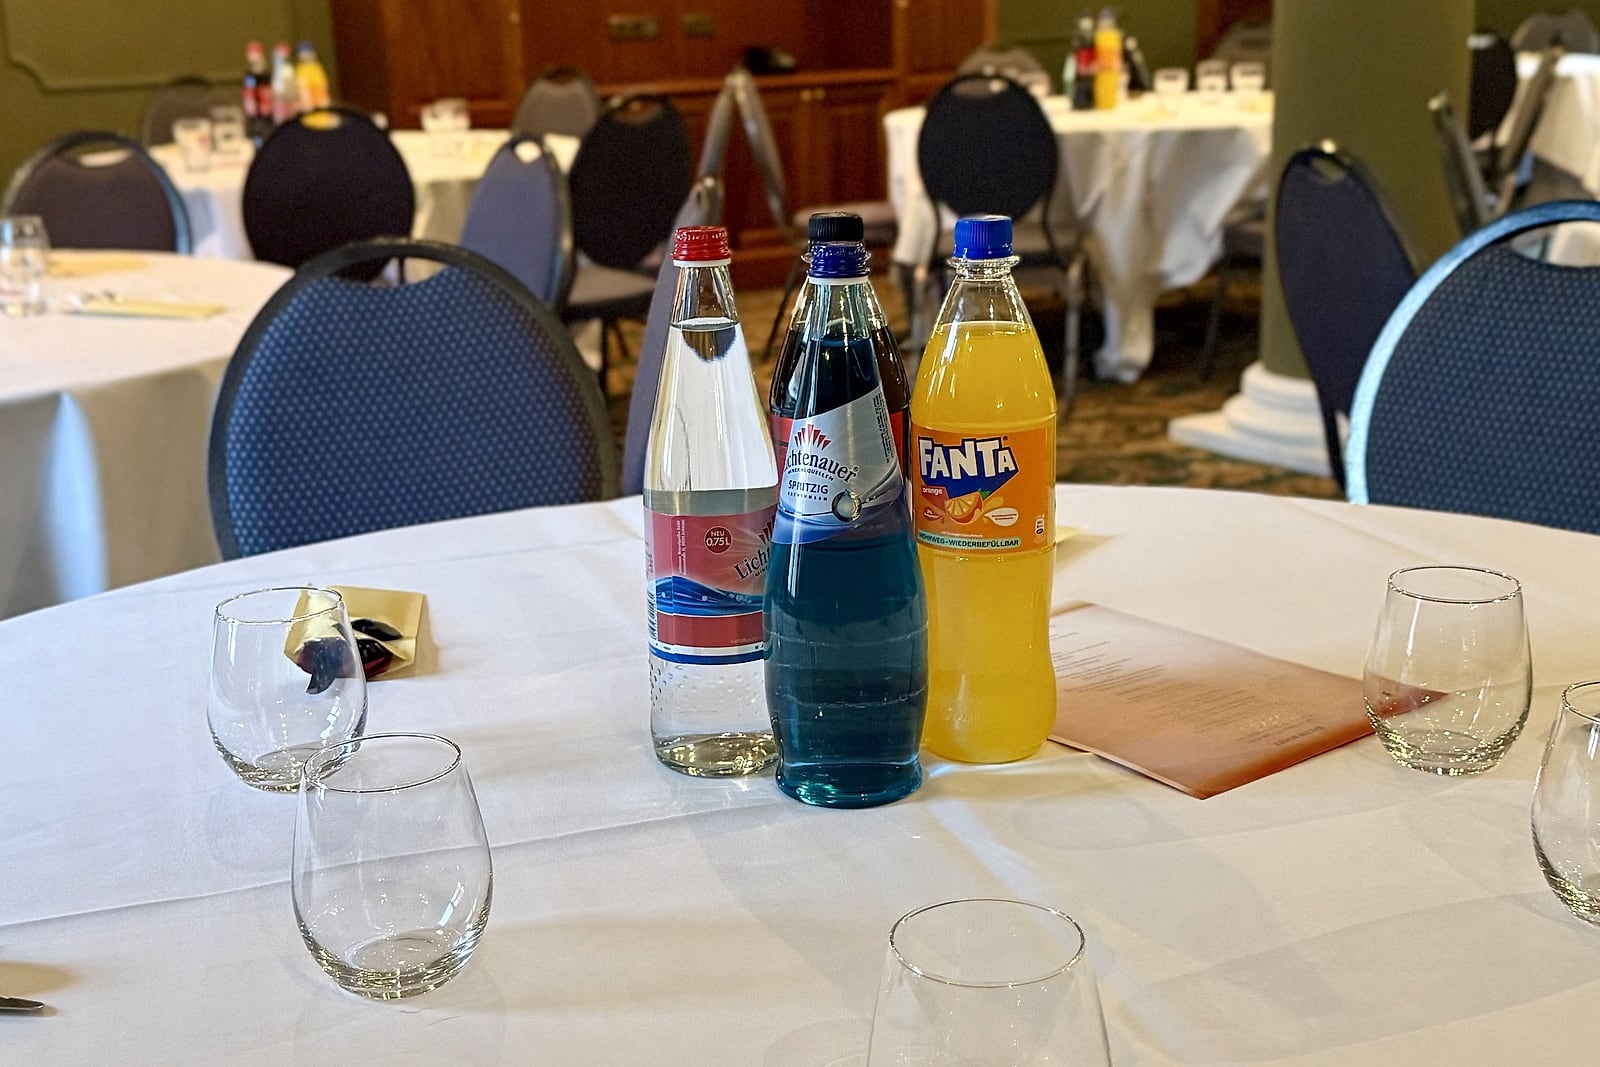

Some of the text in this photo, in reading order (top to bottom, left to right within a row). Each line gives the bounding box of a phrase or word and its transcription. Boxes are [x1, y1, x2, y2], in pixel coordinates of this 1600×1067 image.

[918, 438, 1016, 480] FANTA
[788, 479, 829, 494] SPRITZIG
[921, 486, 943, 496] orange
